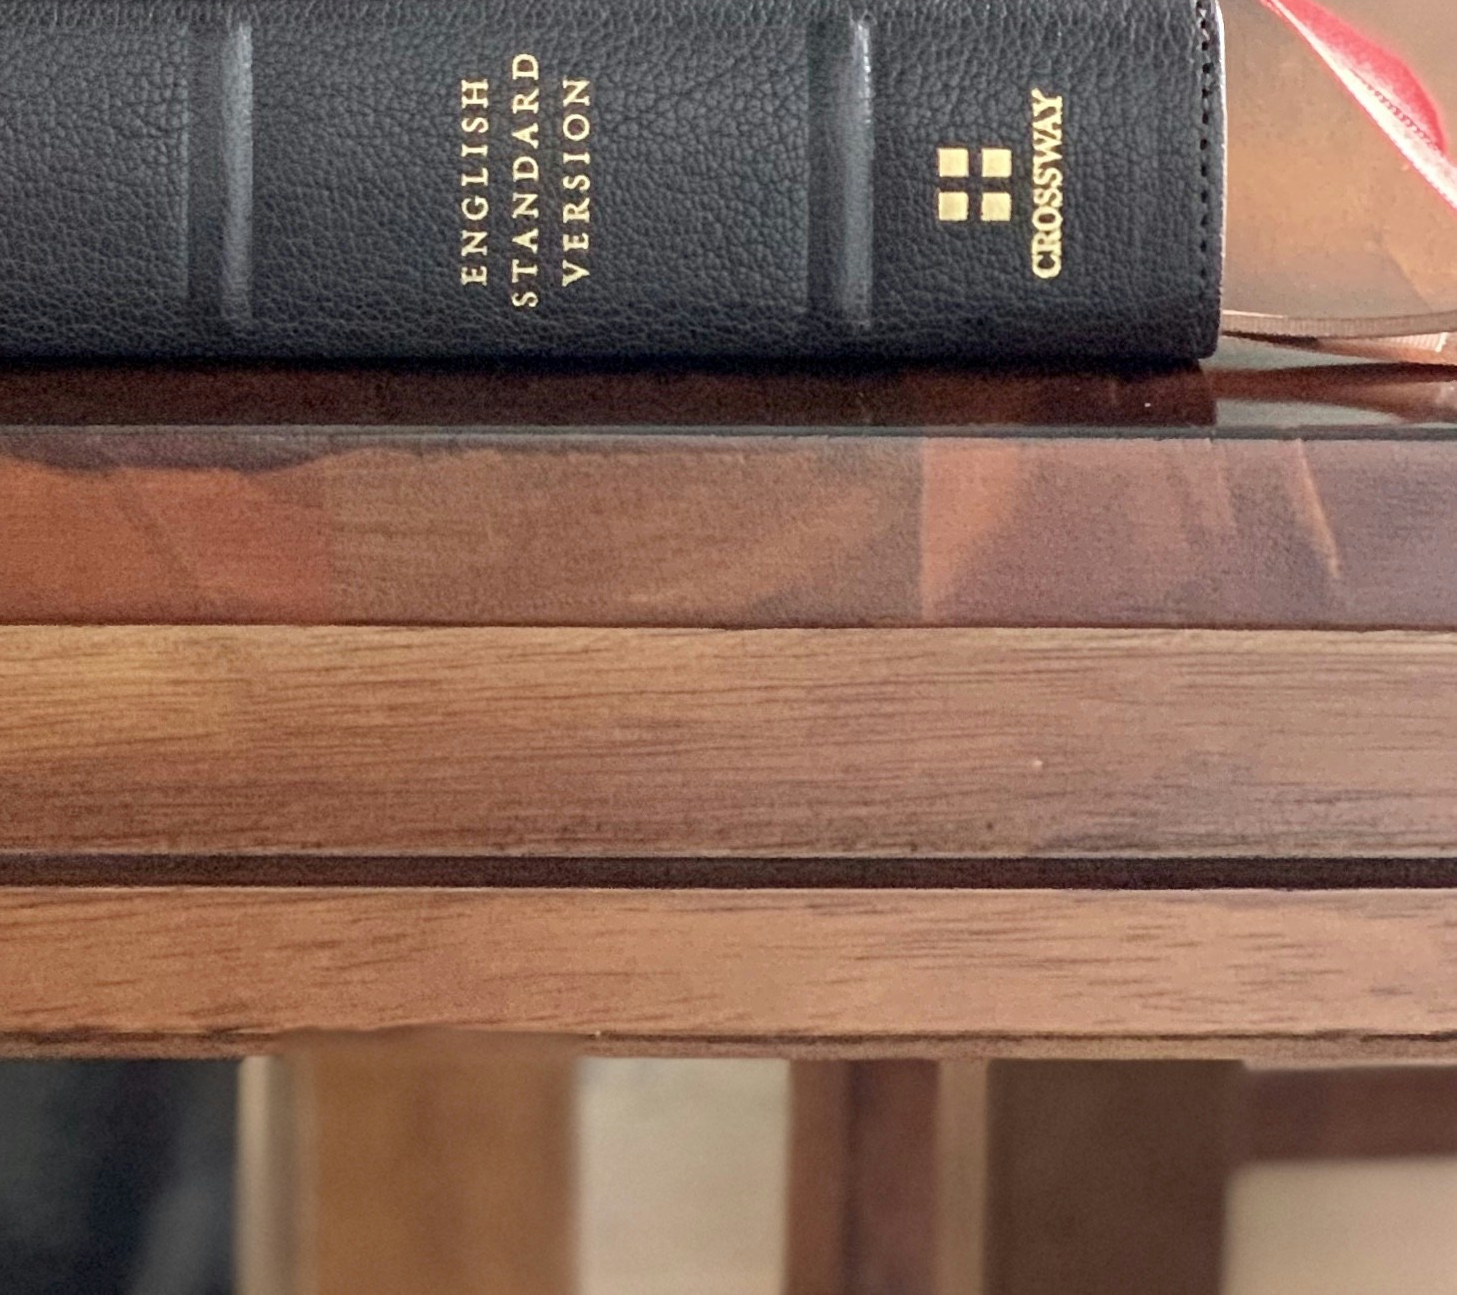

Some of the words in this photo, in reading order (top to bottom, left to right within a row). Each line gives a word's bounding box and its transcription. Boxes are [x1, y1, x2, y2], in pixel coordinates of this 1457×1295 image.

[460, 77, 490, 287] ENGLISH
[511, 53, 540, 308] STANDARD
[561, 78, 591, 288] VERSION
[1031, 87, 1064, 280] CROSSWAY
